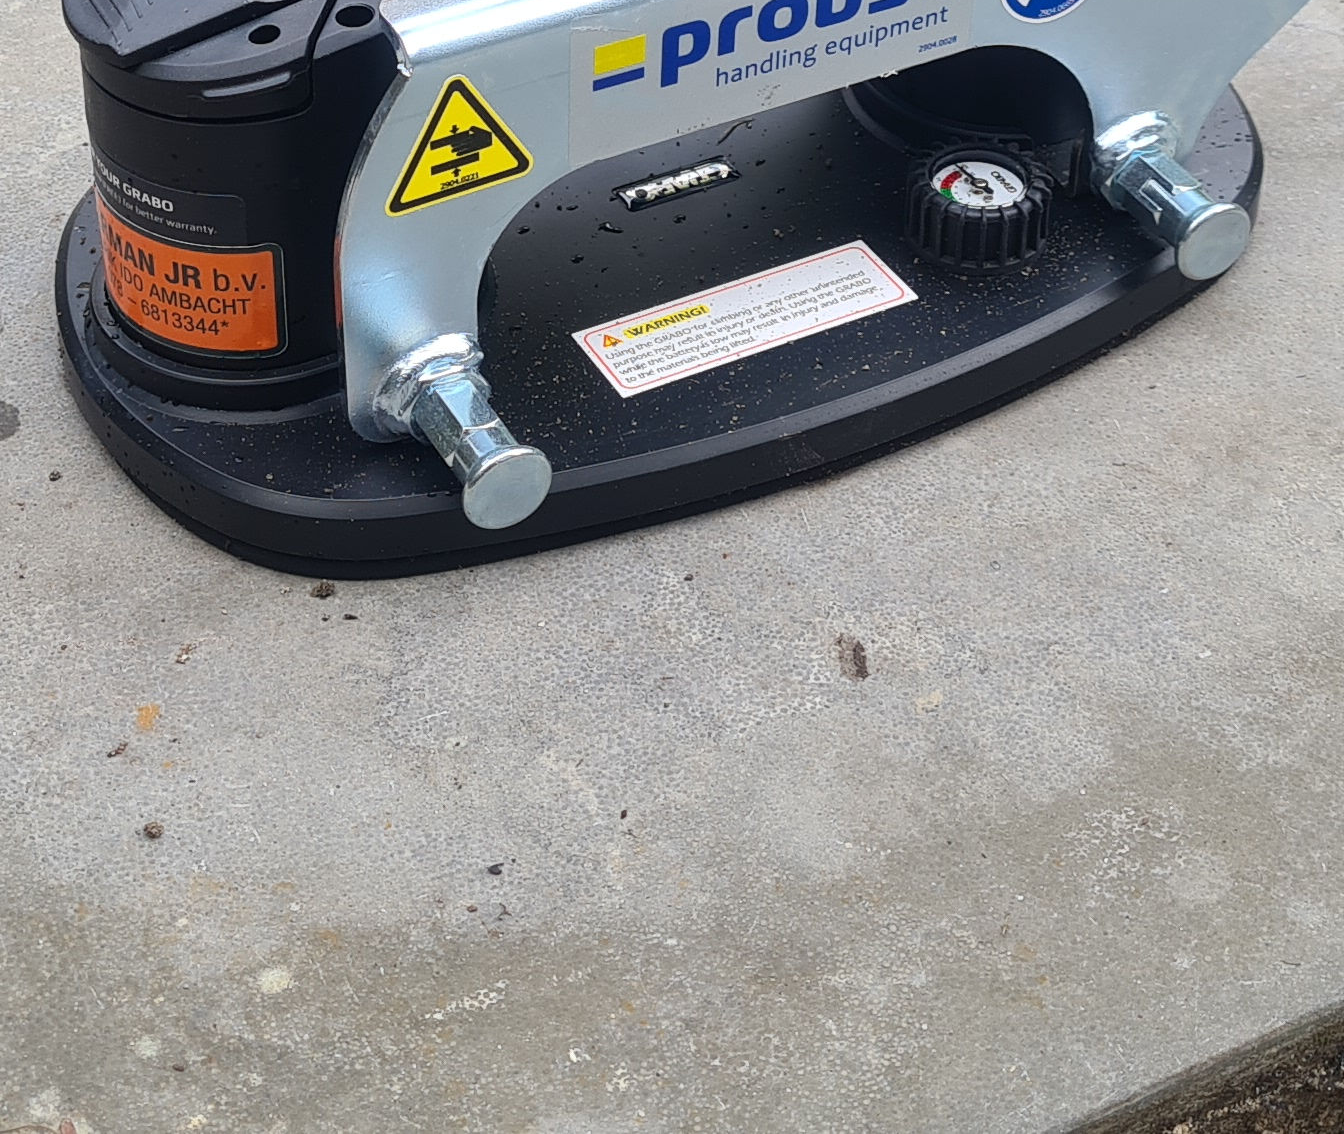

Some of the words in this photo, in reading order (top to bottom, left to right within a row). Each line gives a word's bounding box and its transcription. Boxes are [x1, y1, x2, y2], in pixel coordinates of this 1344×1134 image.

[716, 43, 818, 87] handling
[825, 5, 949, 56] equipment
[122, 182, 174, 212] GRABO
[135, 206, 163, 224] better
[120, 262, 143, 292] IDO
[149, 283, 251, 315] AMBACHT
[164, 261, 202, 289] JR
[213, 268, 267, 293] b.v.
[605, 347, 635, 360] Using
[635, 340, 654, 351] the
[654, 328, 692, 344] GRABO
[694, 322, 707, 331] for
[784, 289, 808, 301] other
[613, 351, 654, 369] purpose
[717, 320, 744, 333] injury
[788, 296, 818, 308] Using
[817, 290, 833, 299] the
[836, 277, 871, 293] GRABO
[626, 306, 708, 336] WARNING!
[647, 356, 665, 366] the
[731, 328, 751, 338] may
[792, 305, 818, 318] injury
[821, 297, 838, 308] and
[625, 375, 637, 383] to
[638, 368, 655, 379] the
[700, 345, 730, 359] being
